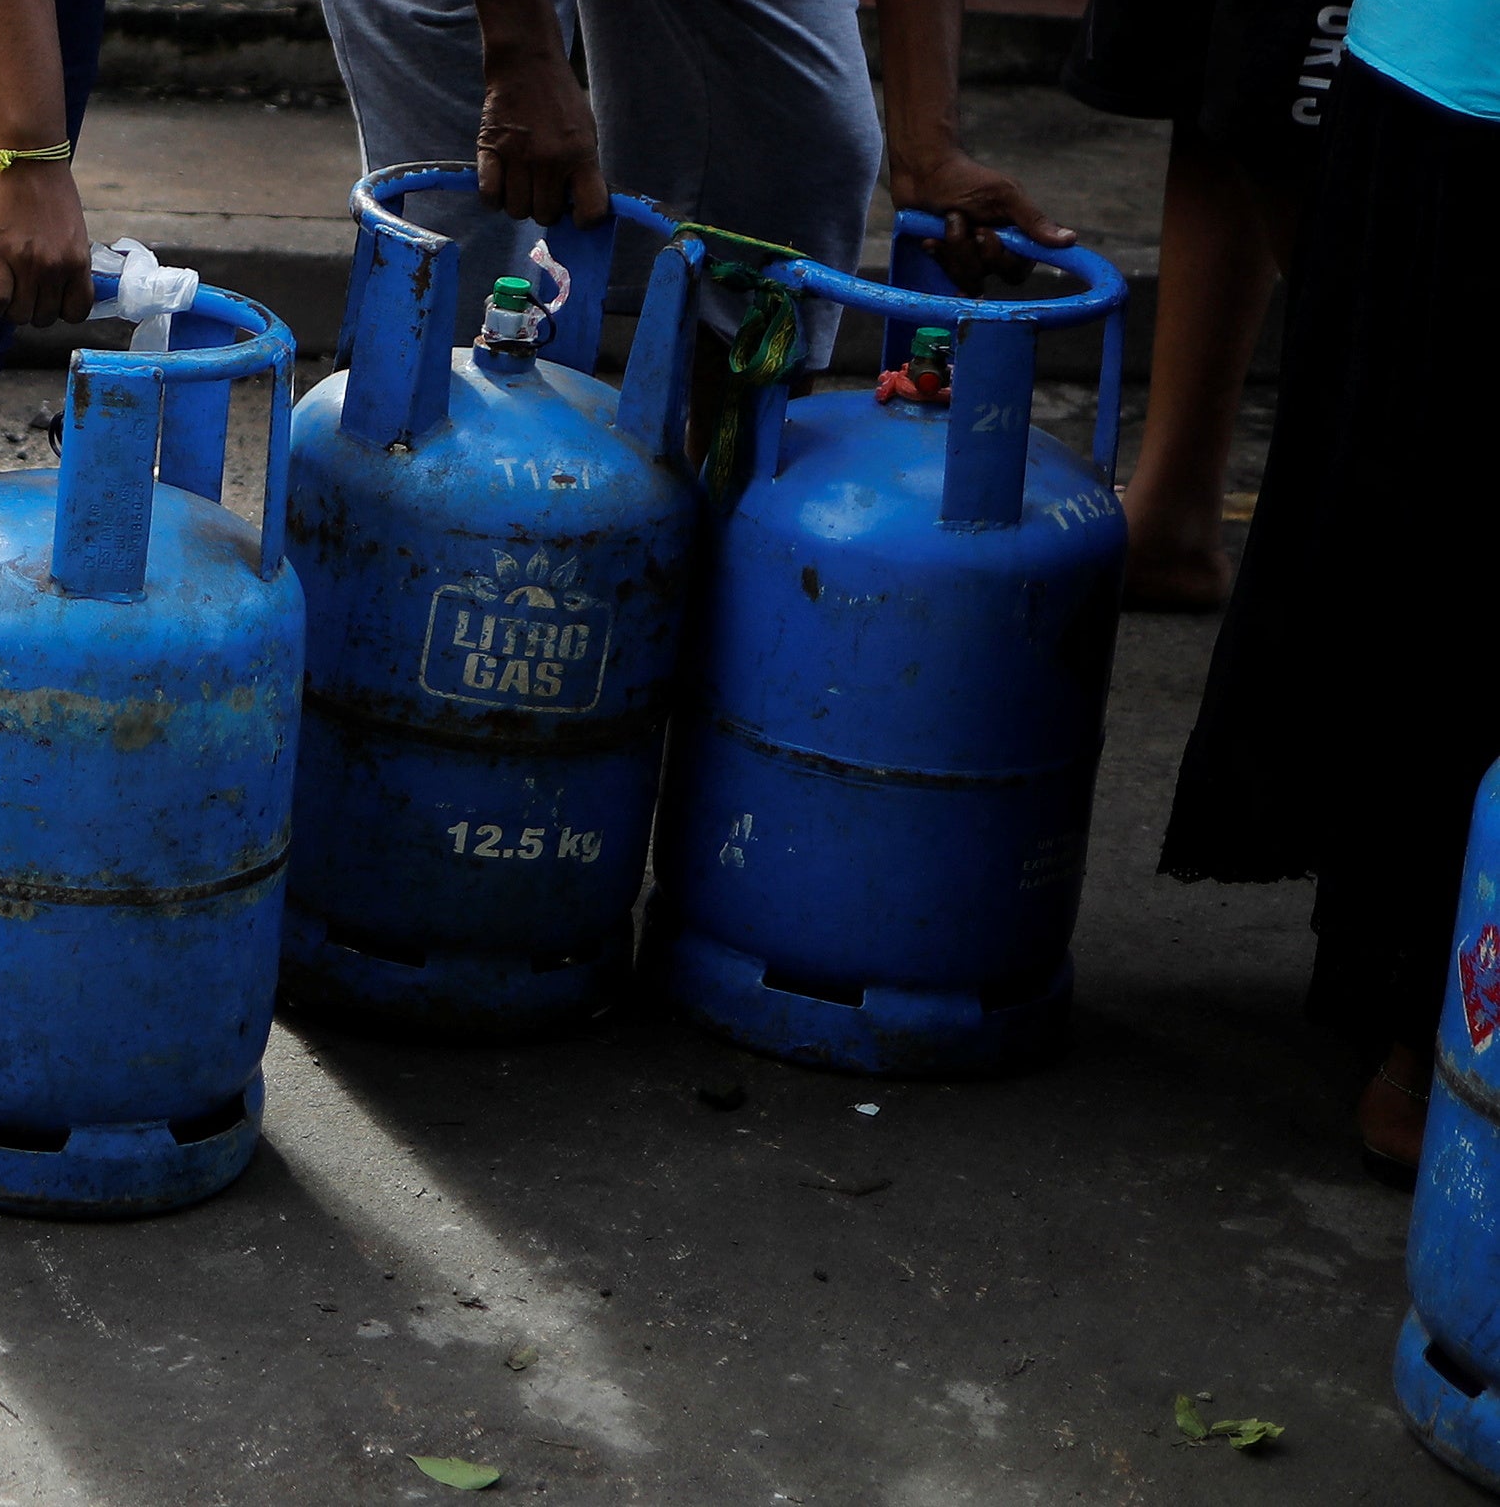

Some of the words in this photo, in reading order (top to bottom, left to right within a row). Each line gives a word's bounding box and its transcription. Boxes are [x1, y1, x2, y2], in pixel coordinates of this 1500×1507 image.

[452, 610, 591, 661] LITRO
[462, 652, 565, 697] GAS
[446, 821, 547, 860] 12.5
[557, 826, 604, 864] kg
